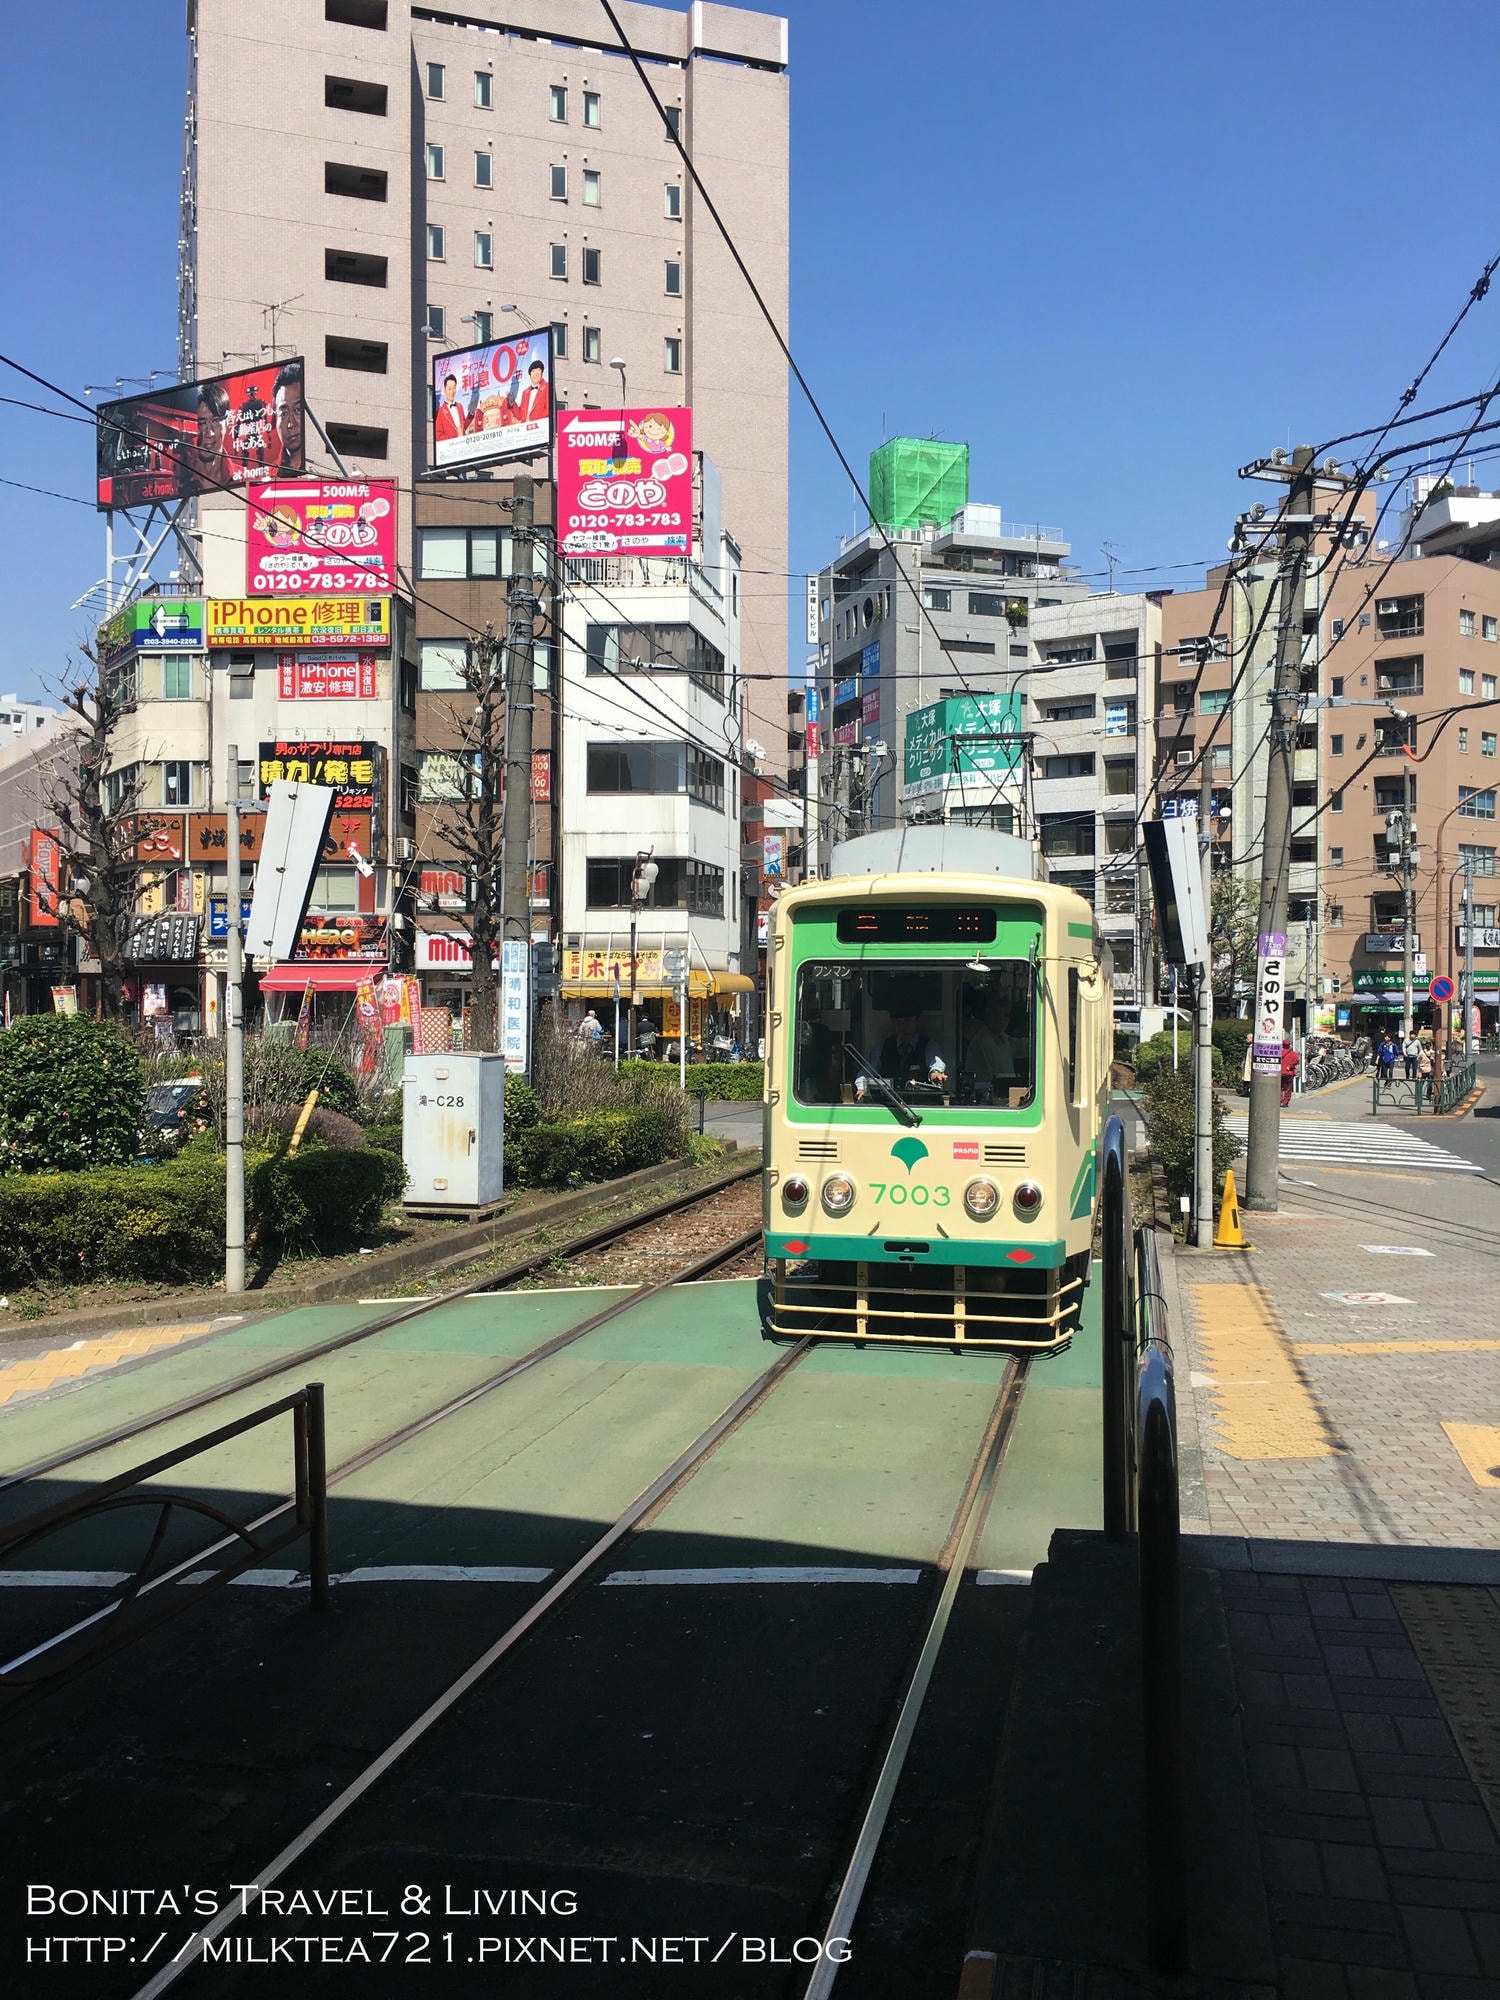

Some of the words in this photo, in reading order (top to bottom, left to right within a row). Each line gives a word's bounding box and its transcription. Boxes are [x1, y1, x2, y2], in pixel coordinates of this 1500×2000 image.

[568, 433, 621, 448] 500M先
[322, 483, 371, 498] 500M先
[577, 479, 667, 511] さのや
[568, 513, 681, 528] 0120-783-783
[302, 522, 378, 547] さのや
[253, 573, 391, 590] 0120-783-783
[213, 600, 307, 626] iPhone
[311, 601, 361, 626] 修理
[312, 634, 387, 644] 03-5972-1399
[301, 664, 355, 679] iPhone
[976, 699, 1001, 718] 大塚
[921, 709, 936, 729] 大塚
[954, 719, 1015, 736] メディカル
[909, 727, 944, 752] メディカル
[909, 745, 944, 769] クリニック
[300, 928, 355, 945] HERO
[814, 965, 851, 977] ワンマン
[1264, 959, 1281, 1014] さのや
[1375, 976, 1395, 984] MOS
[1396, 976, 1430, 984] BUGER
[953, 1147, 979, 1155] PASMO
[869, 1183, 951, 1207] 7003
